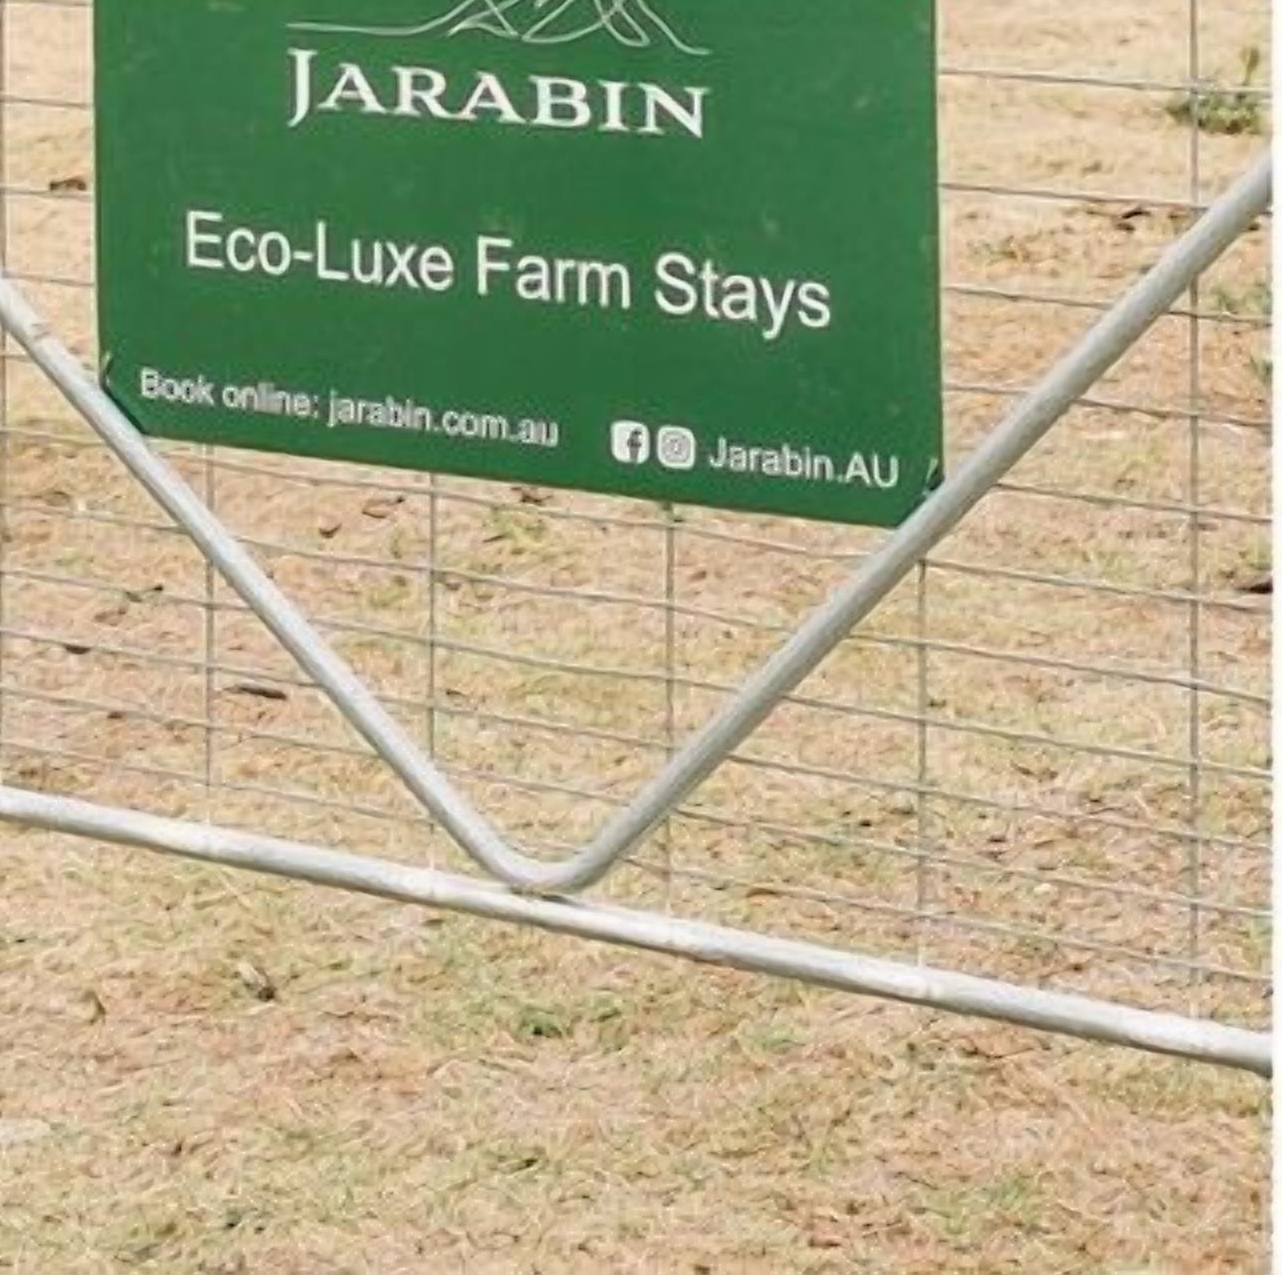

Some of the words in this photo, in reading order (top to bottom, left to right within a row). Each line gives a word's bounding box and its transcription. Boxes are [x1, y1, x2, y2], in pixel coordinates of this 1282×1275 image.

[287, 48, 708, 138] JARABIN
[186, 210, 454, 292] Eco-Luxe
[476, 235, 632, 309] Farm
[654, 252, 832, 340] Stays
[139, 368, 214, 406] Book
[221, 382, 319, 418] online:
[326, 389, 559, 447] jarabin.com.au
[708, 436, 899, 488] Jarabin.AU
